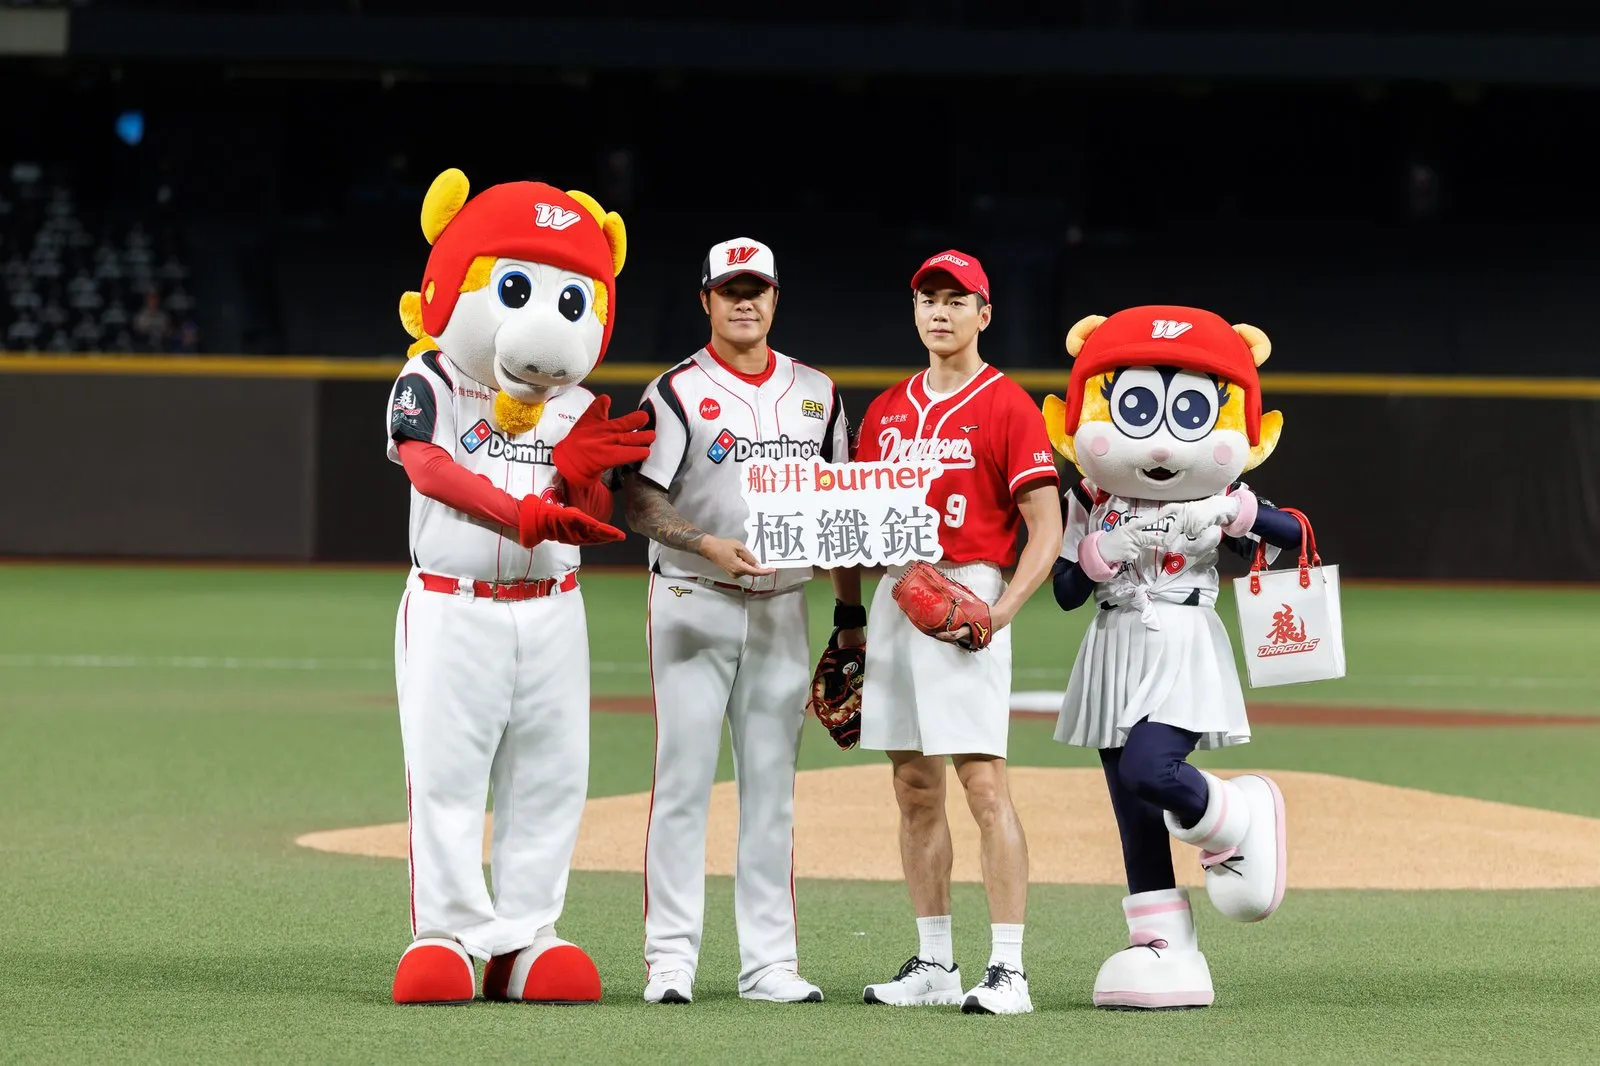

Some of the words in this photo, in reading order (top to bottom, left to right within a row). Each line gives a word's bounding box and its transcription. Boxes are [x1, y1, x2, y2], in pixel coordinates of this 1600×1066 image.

[534, 203, 581, 230] W
[726, 246, 759, 266] W
[1151, 319, 1193, 339] W
[488, 430, 555, 466] Domin
[879, 427, 976, 470] Dragons
[1033, 450, 1054, 465] 味
[748, 464, 808, 493] 船井
[814, 462, 931, 492] burner
[944, 493, 967, 528] 9
[752, 506, 936, 565] 極纖錠
[1257, 637, 1321, 658] DRAGONS
